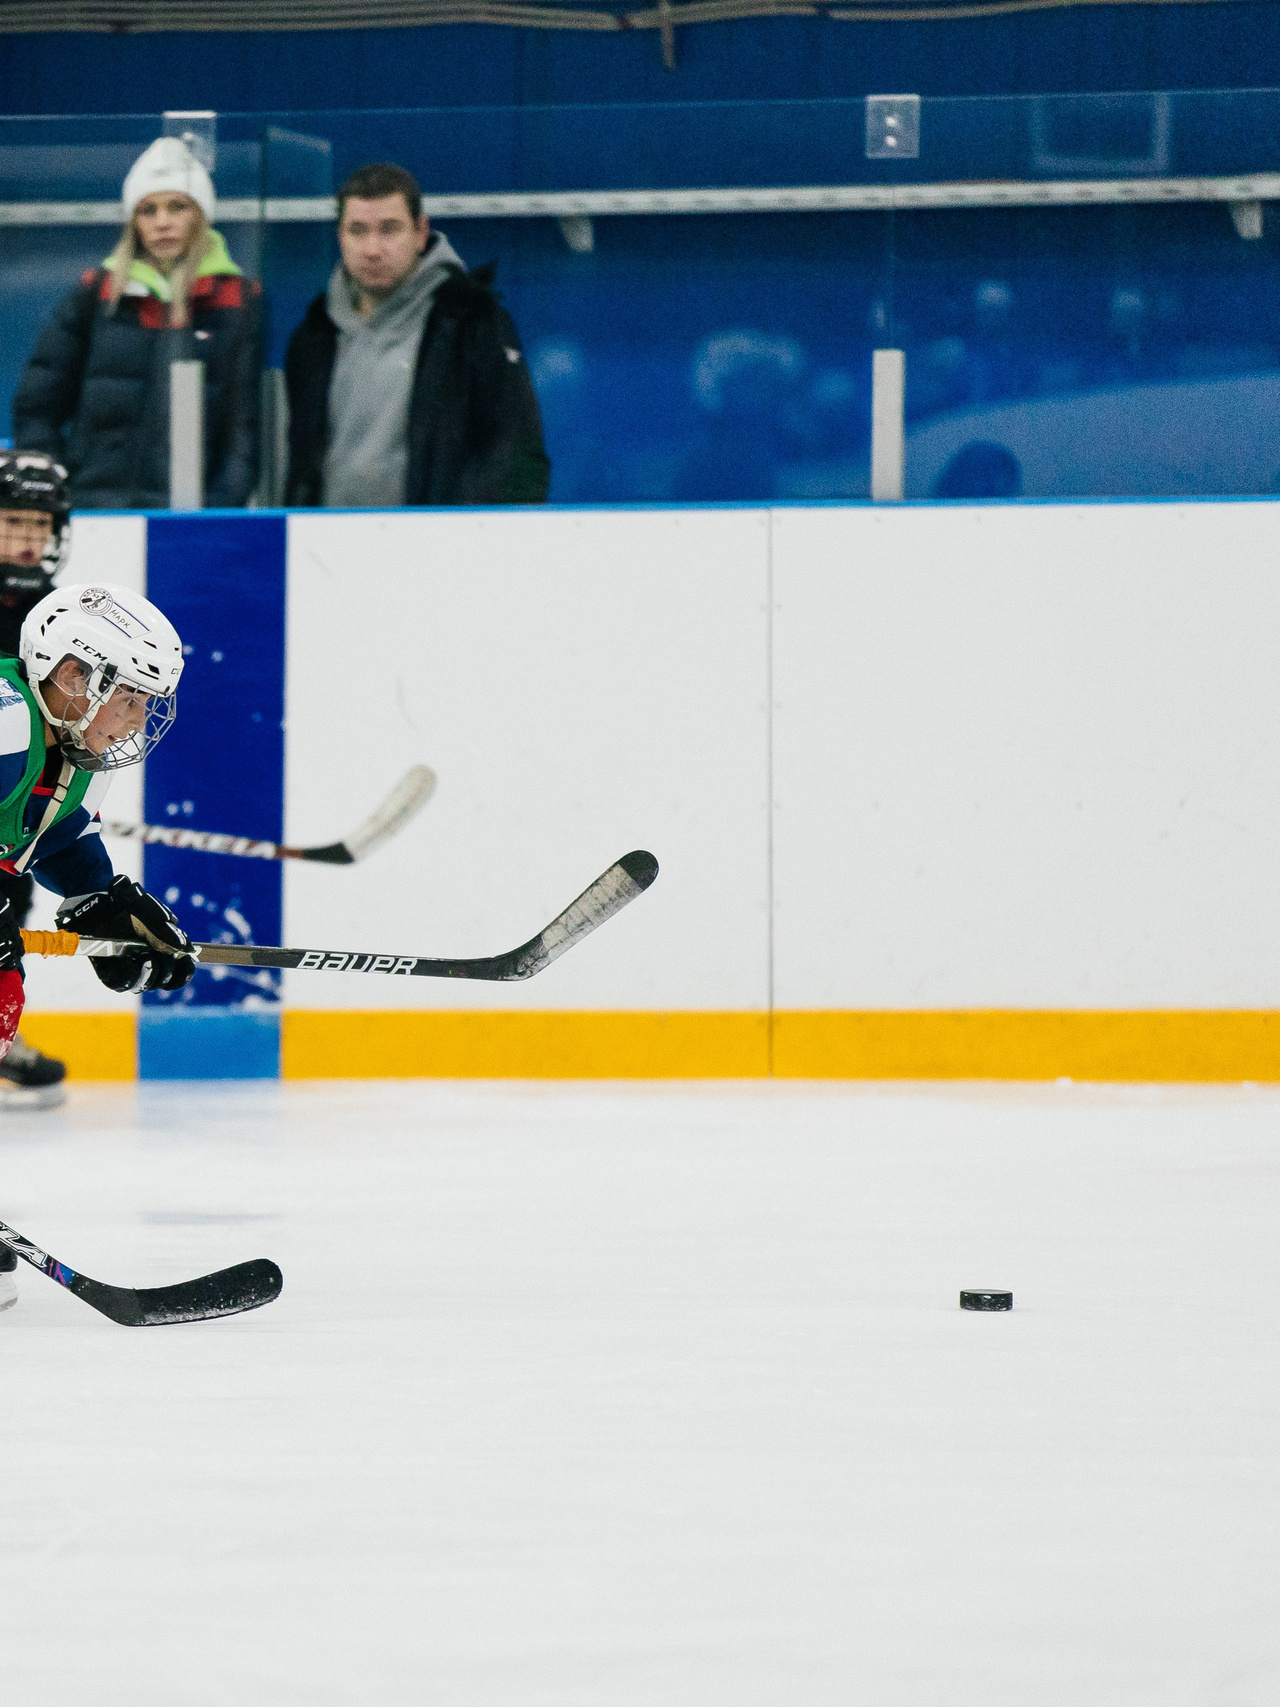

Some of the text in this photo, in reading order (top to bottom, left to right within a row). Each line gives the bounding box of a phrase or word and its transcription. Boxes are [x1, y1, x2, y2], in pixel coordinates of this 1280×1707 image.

[71, 637, 108, 662] CCM
[74, 896, 99, 918] CCM
[296, 950, 418, 976] BAUER
